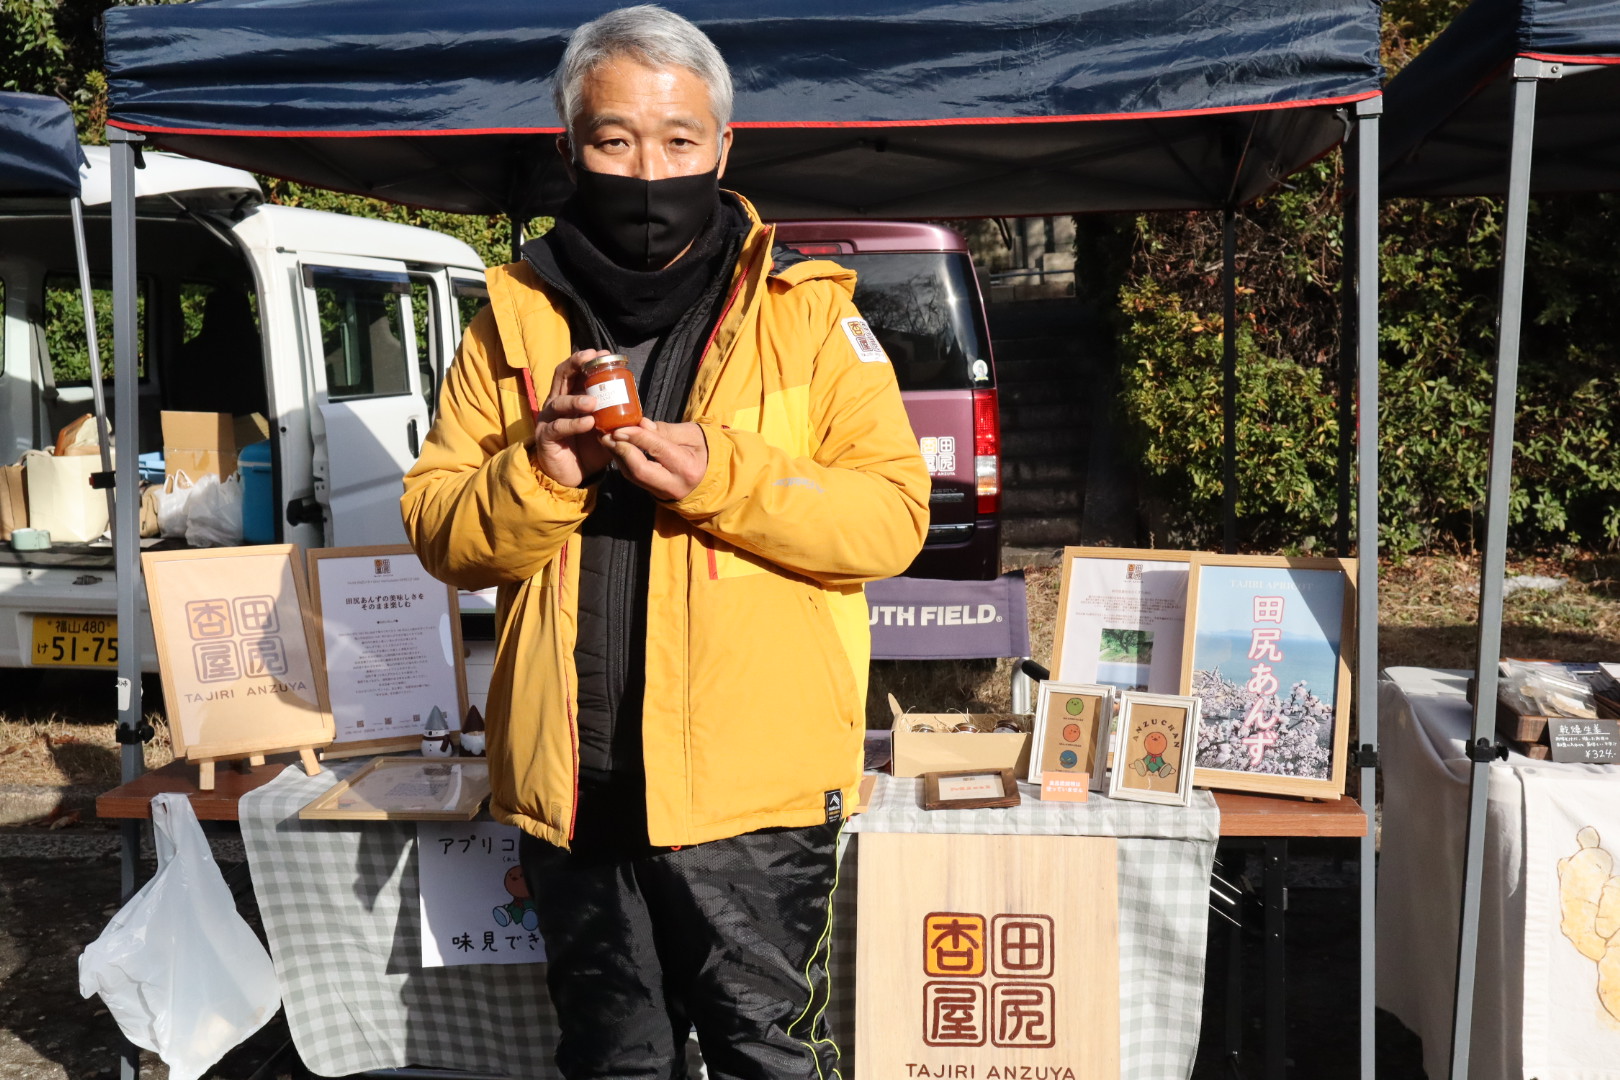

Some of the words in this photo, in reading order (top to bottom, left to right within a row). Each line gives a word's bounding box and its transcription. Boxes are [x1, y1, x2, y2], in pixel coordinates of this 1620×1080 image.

[52, 636, 118, 662] 51-75
[1243, 595, 1285, 766] 田尻あんず
[185, 689, 234, 703] TAJIRI
[247, 681, 307, 697] ANZUYA
[1133, 718, 1181, 749] ANZUCHAN
[438, 834, 515, 854] アプリコ
[452, 931, 540, 952] 味見でき
[905, 1063, 975, 1079] TAJIRI
[987, 1065, 1076, 1080] ANZUYA
